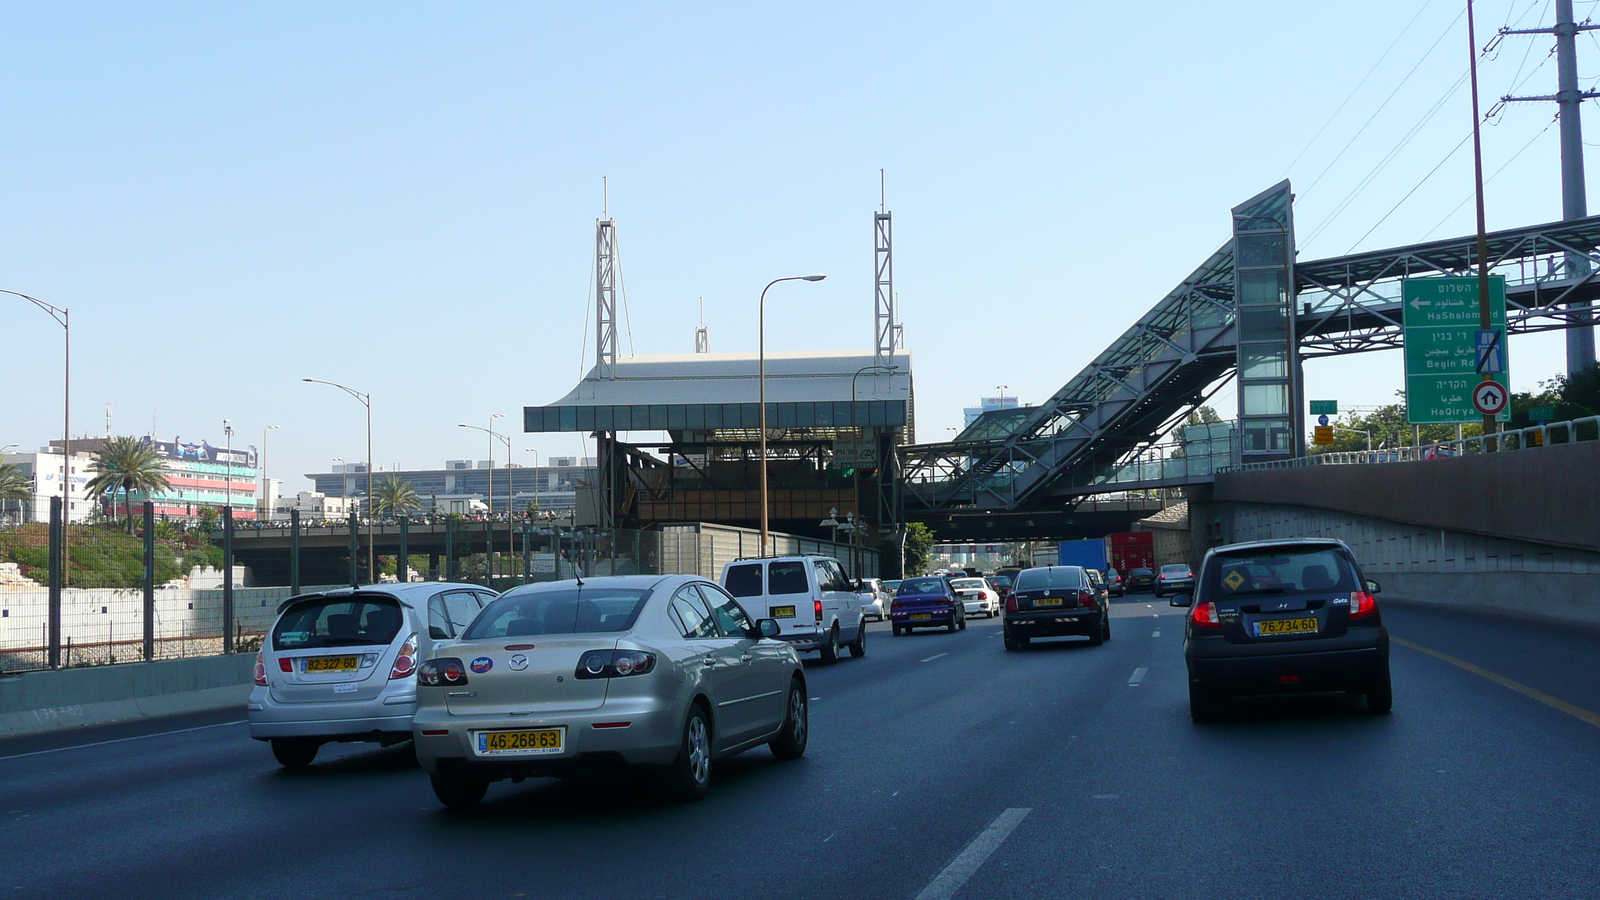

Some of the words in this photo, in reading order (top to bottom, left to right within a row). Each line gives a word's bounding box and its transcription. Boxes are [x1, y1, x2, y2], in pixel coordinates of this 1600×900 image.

[1438, 284, 1472, 293] השלום
[1427, 311, 1480, 320] HaShalom
[1432, 332, 1452, 342] בגין
[1454, 345, 1476, 357] طريق
[1426, 360, 1456, 369] Begin
[1461, 359, 1475, 367] Rd
[1436, 380, 1467, 390] הקריה
[1431, 408, 1475, 417] HaQirya
